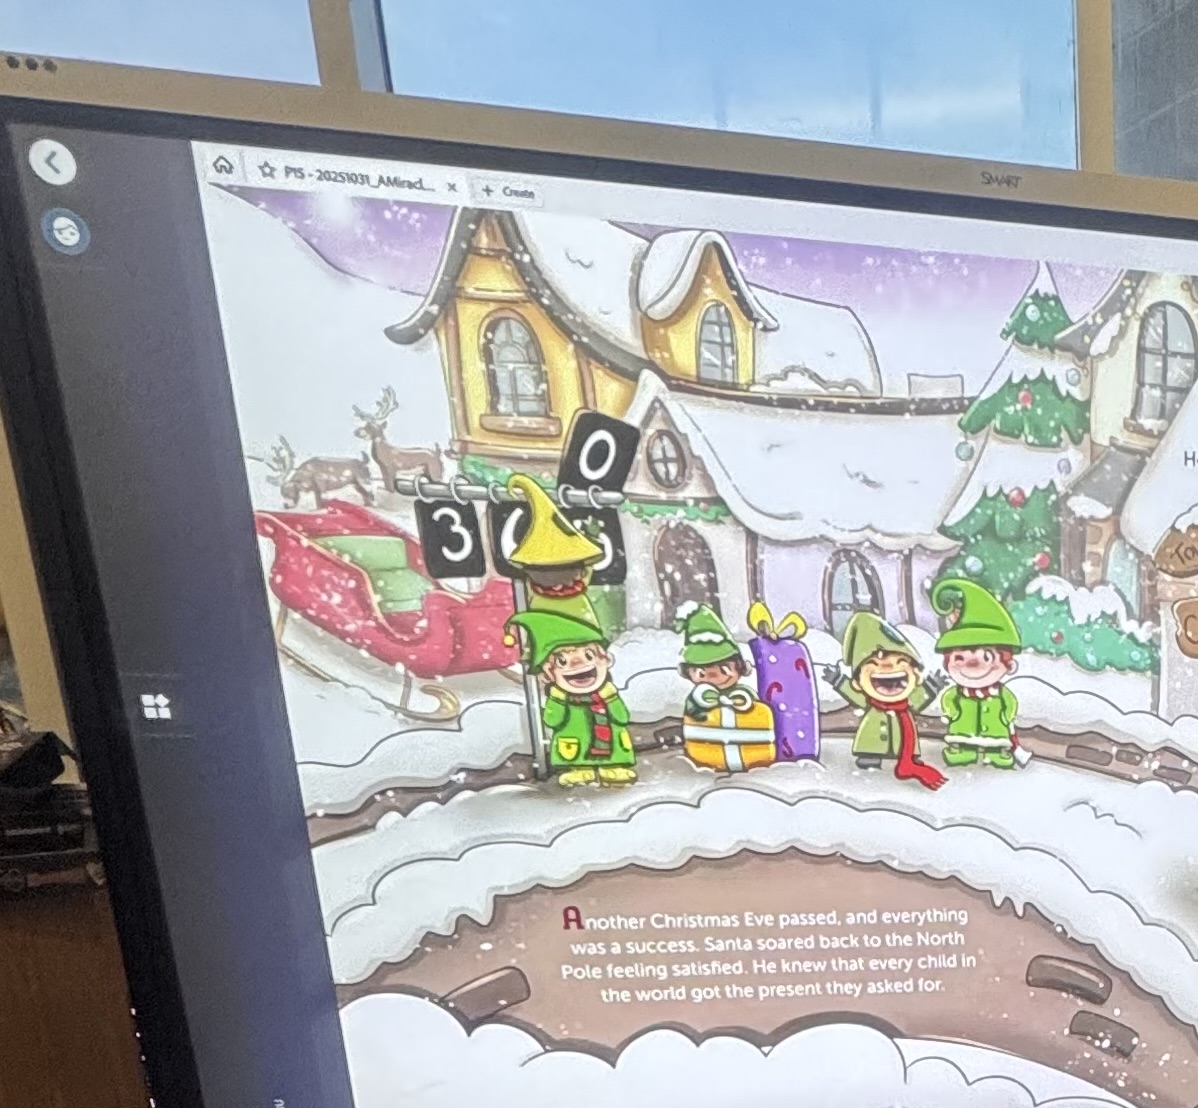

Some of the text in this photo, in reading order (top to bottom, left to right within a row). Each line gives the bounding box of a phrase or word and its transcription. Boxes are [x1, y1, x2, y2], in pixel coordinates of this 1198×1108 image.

[502, 186, 535, 199] Create
[981, 170, 1023, 189] SMART
[432, 507, 473, 562] 3
[562, 905, 968, 931] Another Christmas Eve passed, and everything
[570, 930, 965, 955] was a success. Santa soared back to the North
[561, 953, 976, 981] Pole feeling satisfied. He knew that every child in
[600, 976, 945, 1003] the world got the present they asked for.
